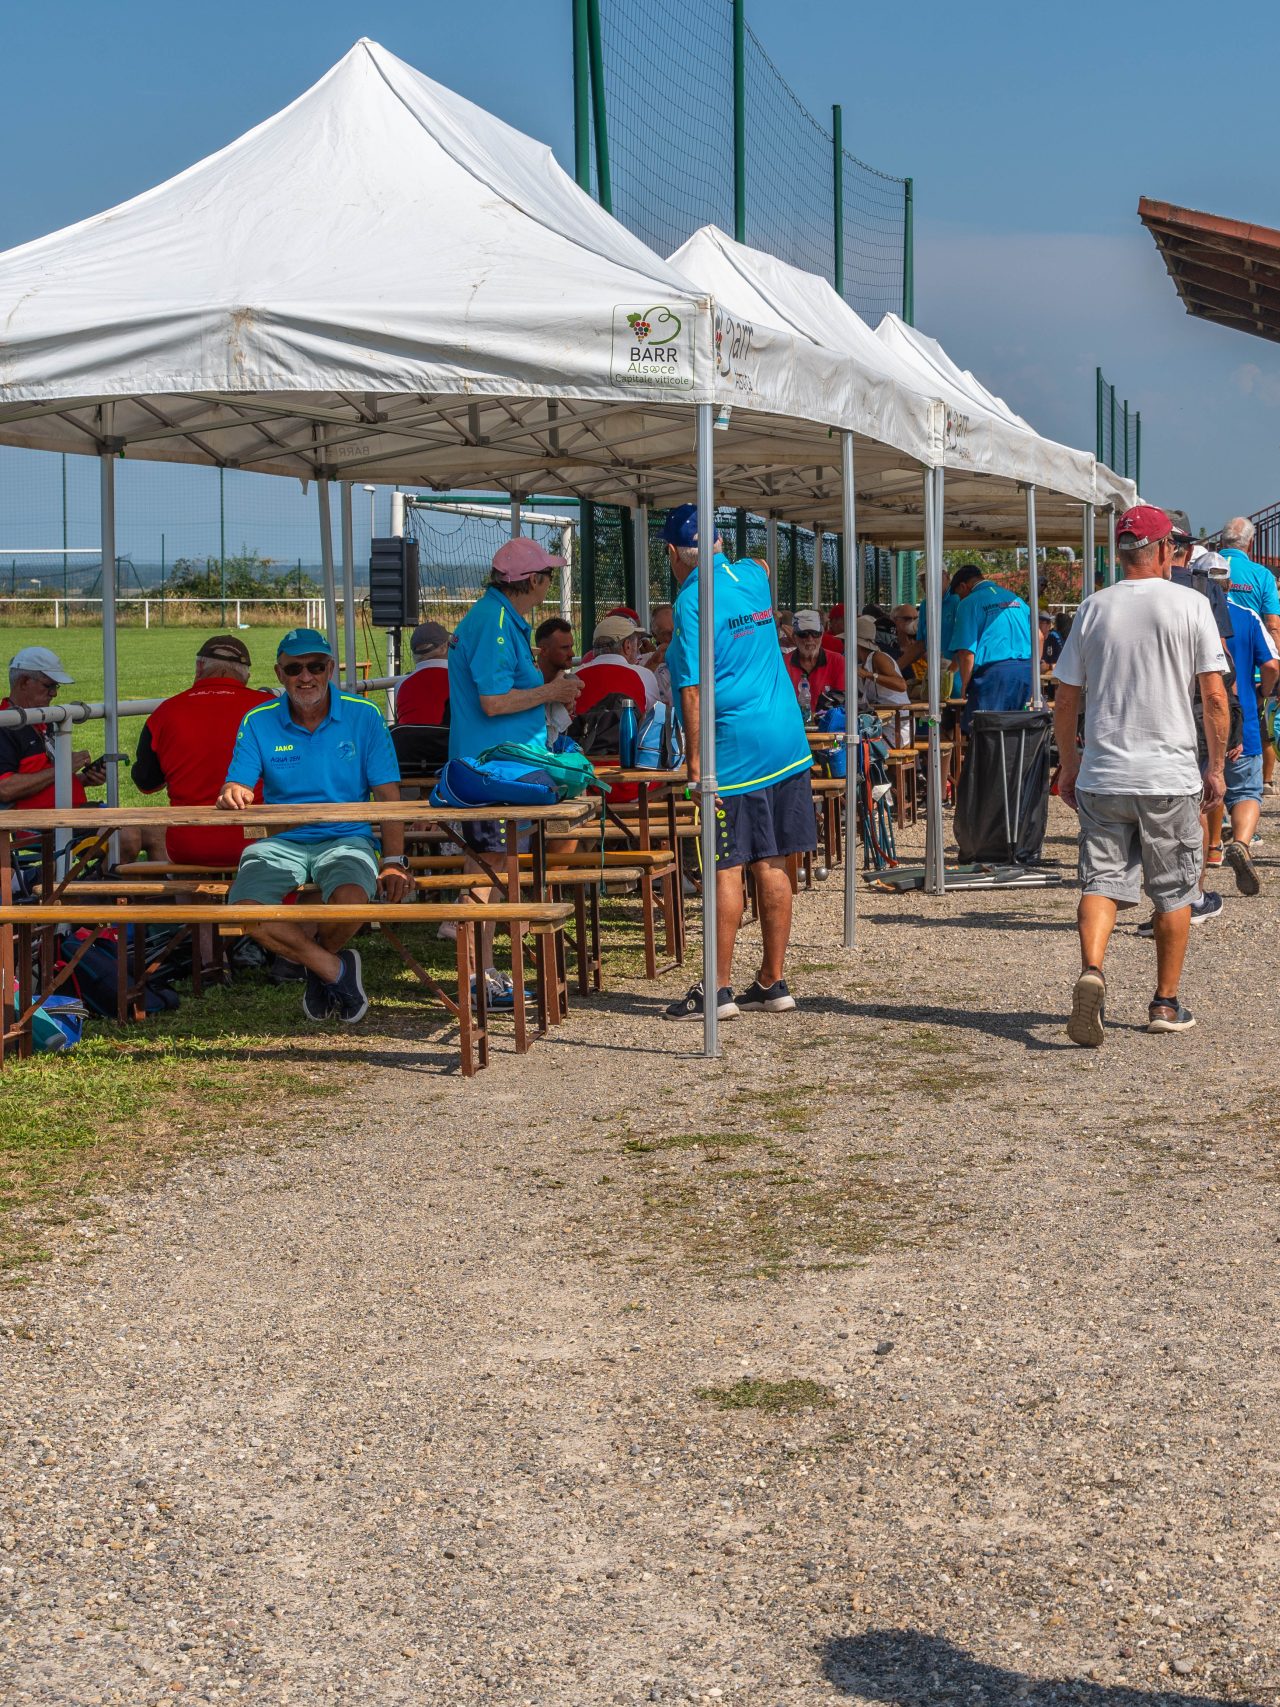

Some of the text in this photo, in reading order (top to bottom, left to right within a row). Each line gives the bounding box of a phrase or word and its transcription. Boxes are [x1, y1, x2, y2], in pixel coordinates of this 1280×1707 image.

[630, 347, 678, 363] BARR
[615, 373, 689, 386] Capitale viticole
